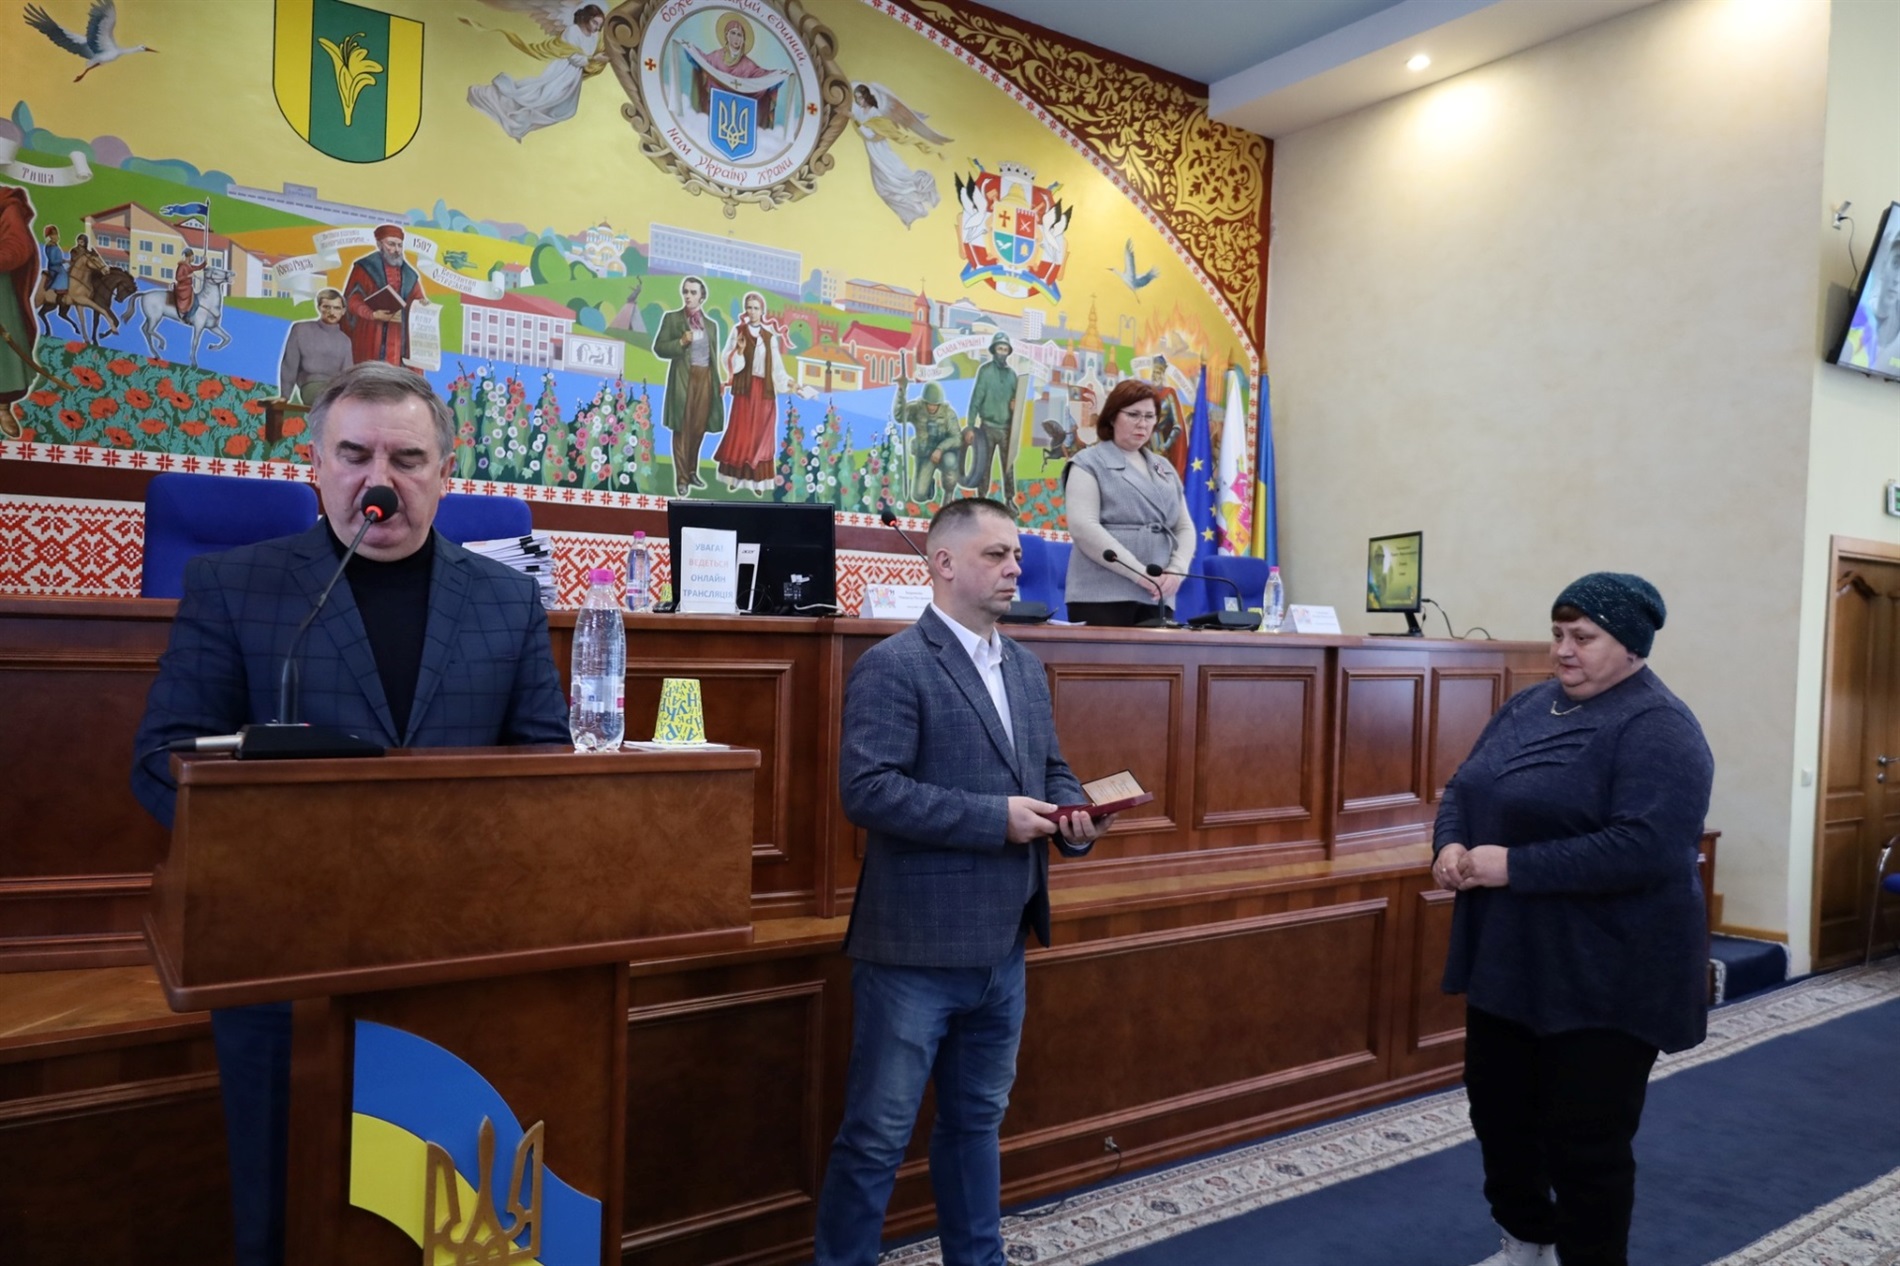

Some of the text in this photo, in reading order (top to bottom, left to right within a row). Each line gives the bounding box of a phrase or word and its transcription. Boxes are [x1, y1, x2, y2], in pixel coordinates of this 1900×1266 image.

[695, 544, 724, 552] УВАГА!
[688, 558, 729, 568] ВЕДЕТЬСЯ
[690, 573, 726, 583] ОНЛАЙН
[683, 589, 734, 599] ТРАНСЛЯЦІЯ
